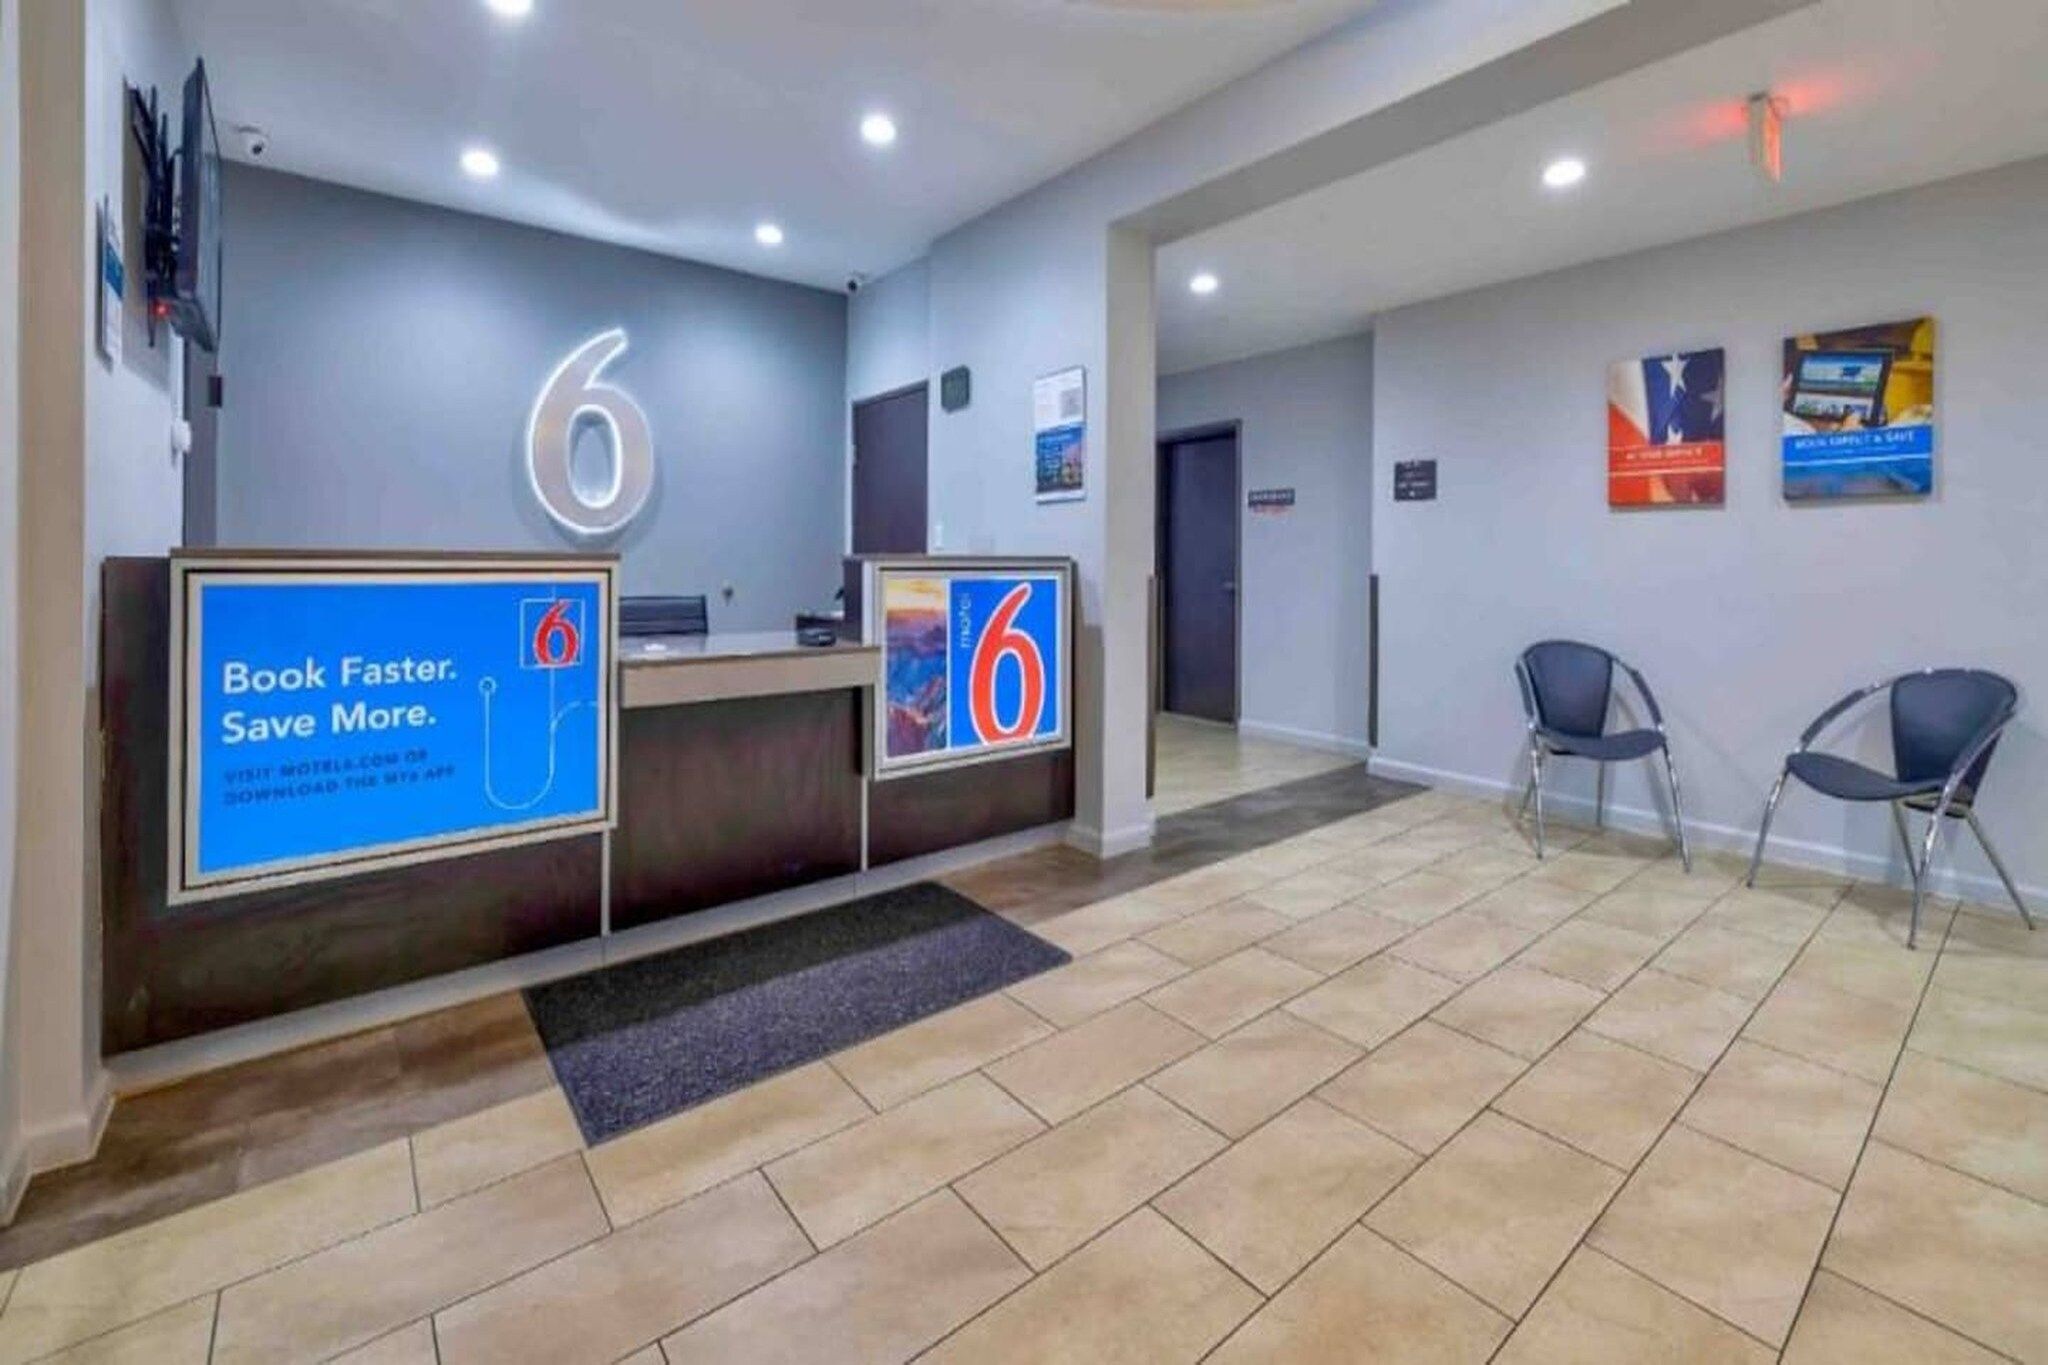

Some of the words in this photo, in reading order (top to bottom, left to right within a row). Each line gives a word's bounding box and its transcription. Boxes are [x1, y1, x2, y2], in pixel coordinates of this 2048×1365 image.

[526, 328, 654, 534] 6
[533, 598, 579, 668] 6
[959, 592, 971, 648] motel
[222, 656, 327, 694] Book
[340, 655, 457, 687] Faster.
[969, 582, 1046, 746] 6
[221, 710, 316, 744] Save
[330, 701, 437, 734] More.
[224, 767, 271, 784] VISIT
[405, 748, 428, 763] OR
[224, 779, 340, 806] DOWNLOAD
[346, 774, 377, 788] THE
[425, 764, 454, 781] APP
